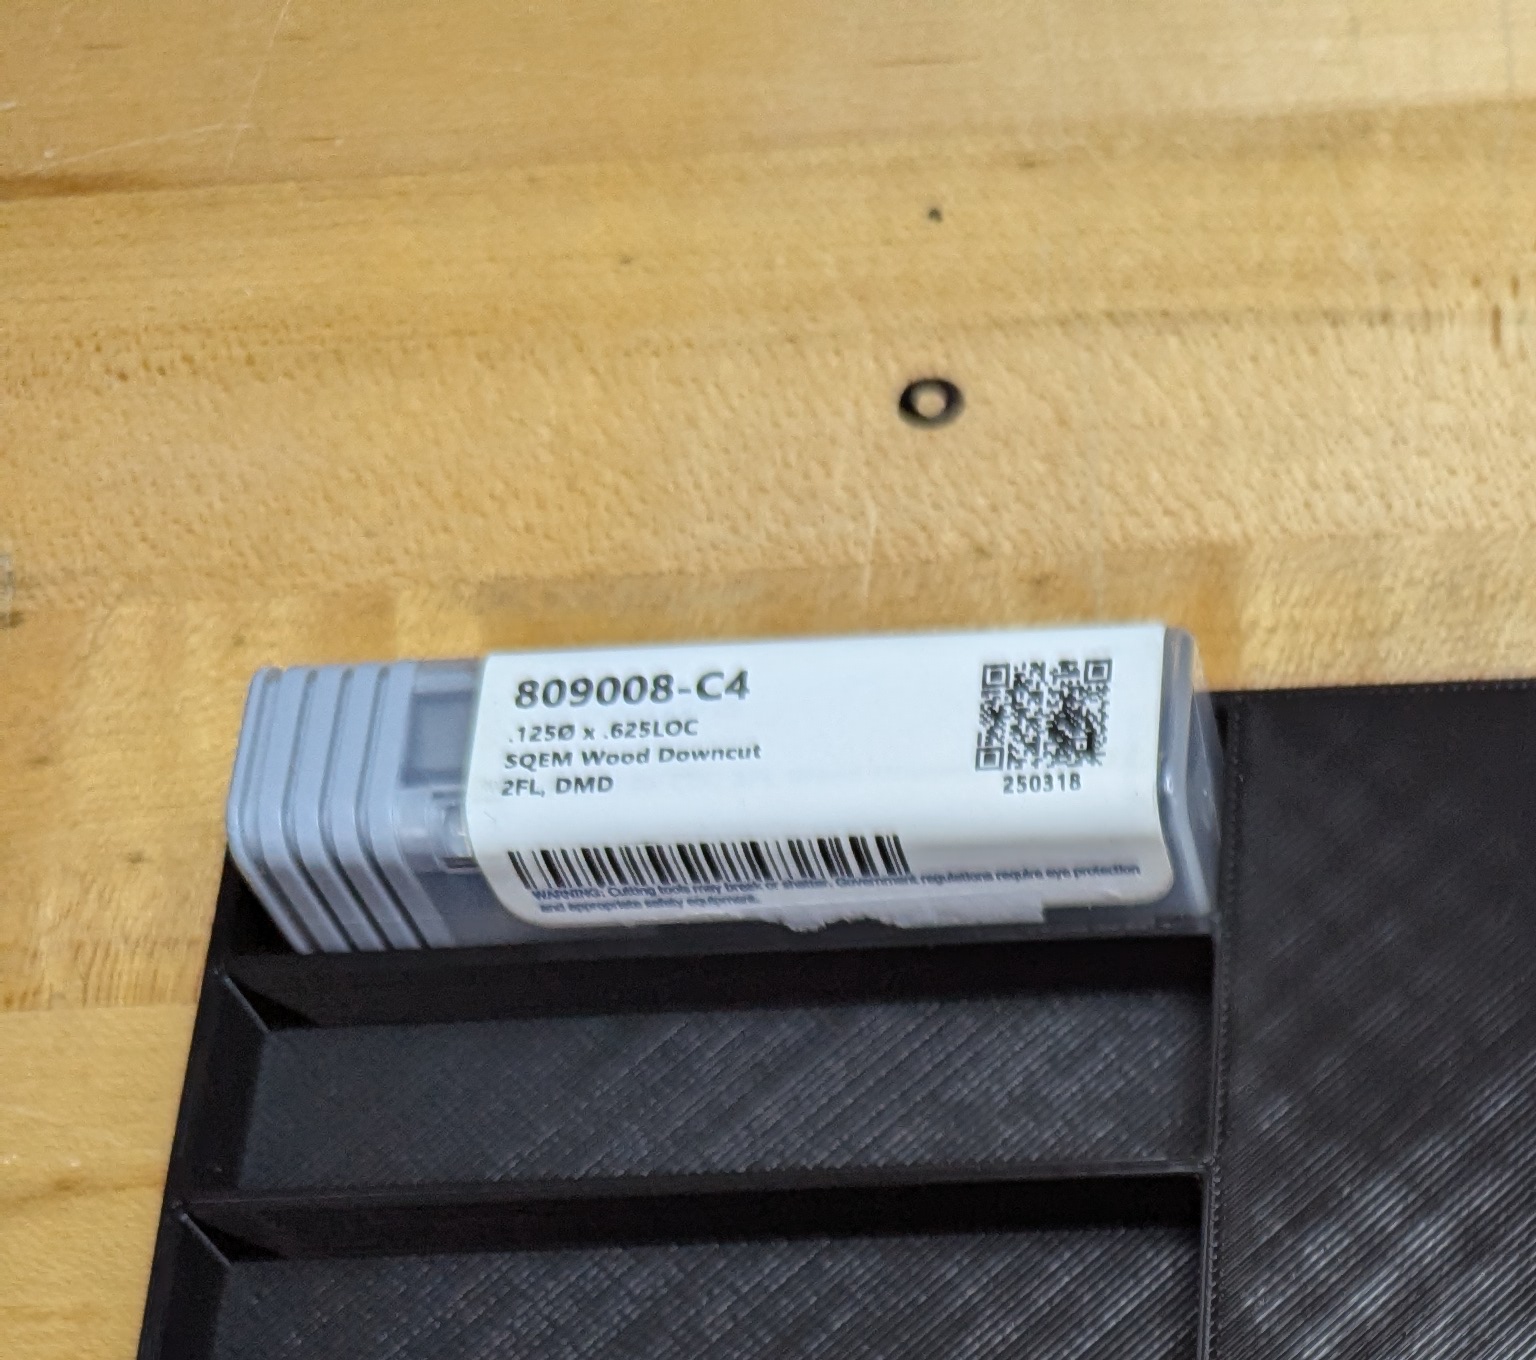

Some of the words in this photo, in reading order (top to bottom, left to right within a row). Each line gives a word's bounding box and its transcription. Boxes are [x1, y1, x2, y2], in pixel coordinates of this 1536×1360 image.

[514, 670, 750, 709] 809008-C4
[582, 727, 596, 741] x
[602, 719, 700, 741] .625LOC
[504, 751, 573, 772] SQEM
[581, 747, 651, 767] Wood
[658, 743, 762, 764] Downcut
[501, 778, 546, 798] 2FL,
[555, 775, 614, 795] DMD
[1003, 773, 1082, 794] 250318
[608, 884, 657, 898] Cutting
[658, 883, 690, 896] tools
[692, 882, 721, 896] may
[724, 880, 761, 893] break
[764, 880, 777, 890] or
[995, 869, 1043, 881] require
[1045, 868, 1071, 880] eye
[1072, 863, 1141, 879] protection
[539, 902, 565, 913] and
